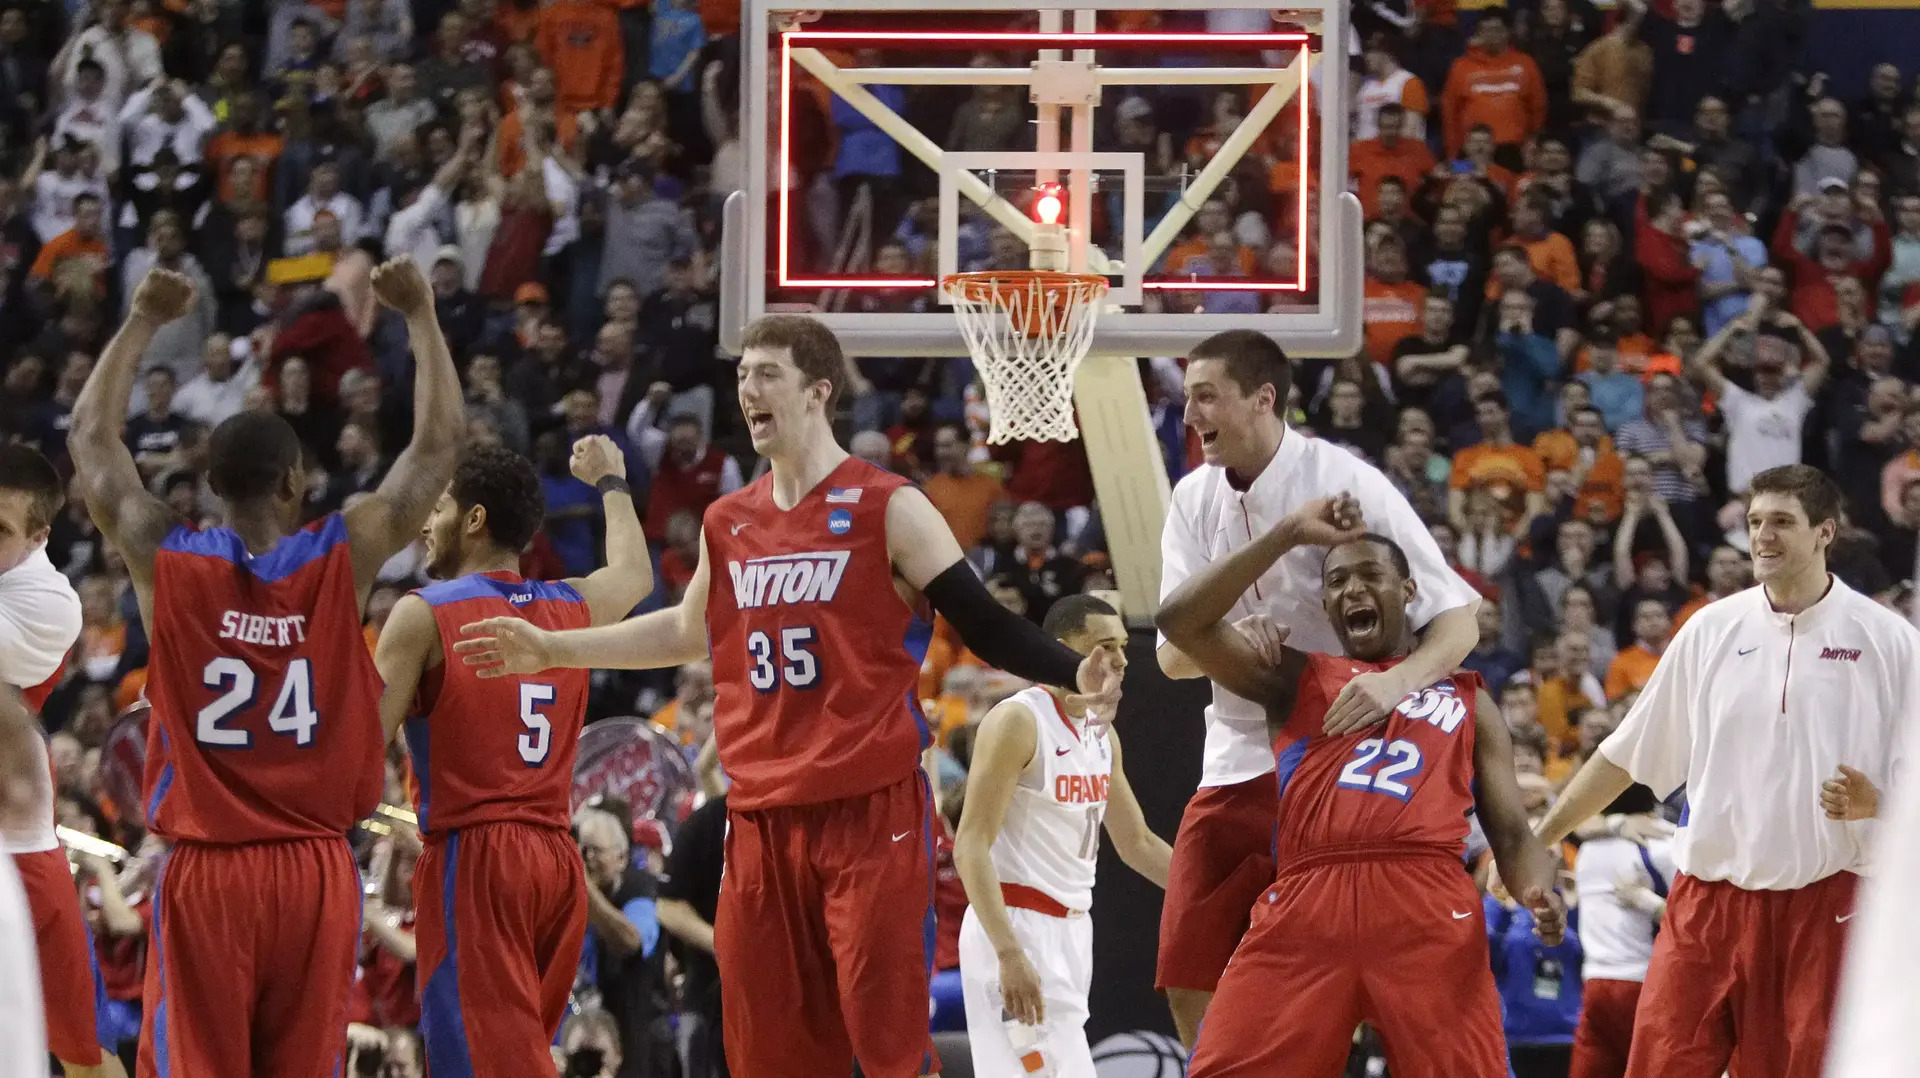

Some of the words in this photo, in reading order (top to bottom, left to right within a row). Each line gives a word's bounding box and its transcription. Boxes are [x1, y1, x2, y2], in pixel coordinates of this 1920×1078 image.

[728, 550, 851, 610] DAYTON
[218, 610, 306, 647] SIBERT
[747, 627, 820, 693] 35
[1819, 647, 1862, 662] DAYTON
[196, 656, 320, 748] 24
[517, 682, 556, 768] 5
[1337, 738, 1423, 803] 22
